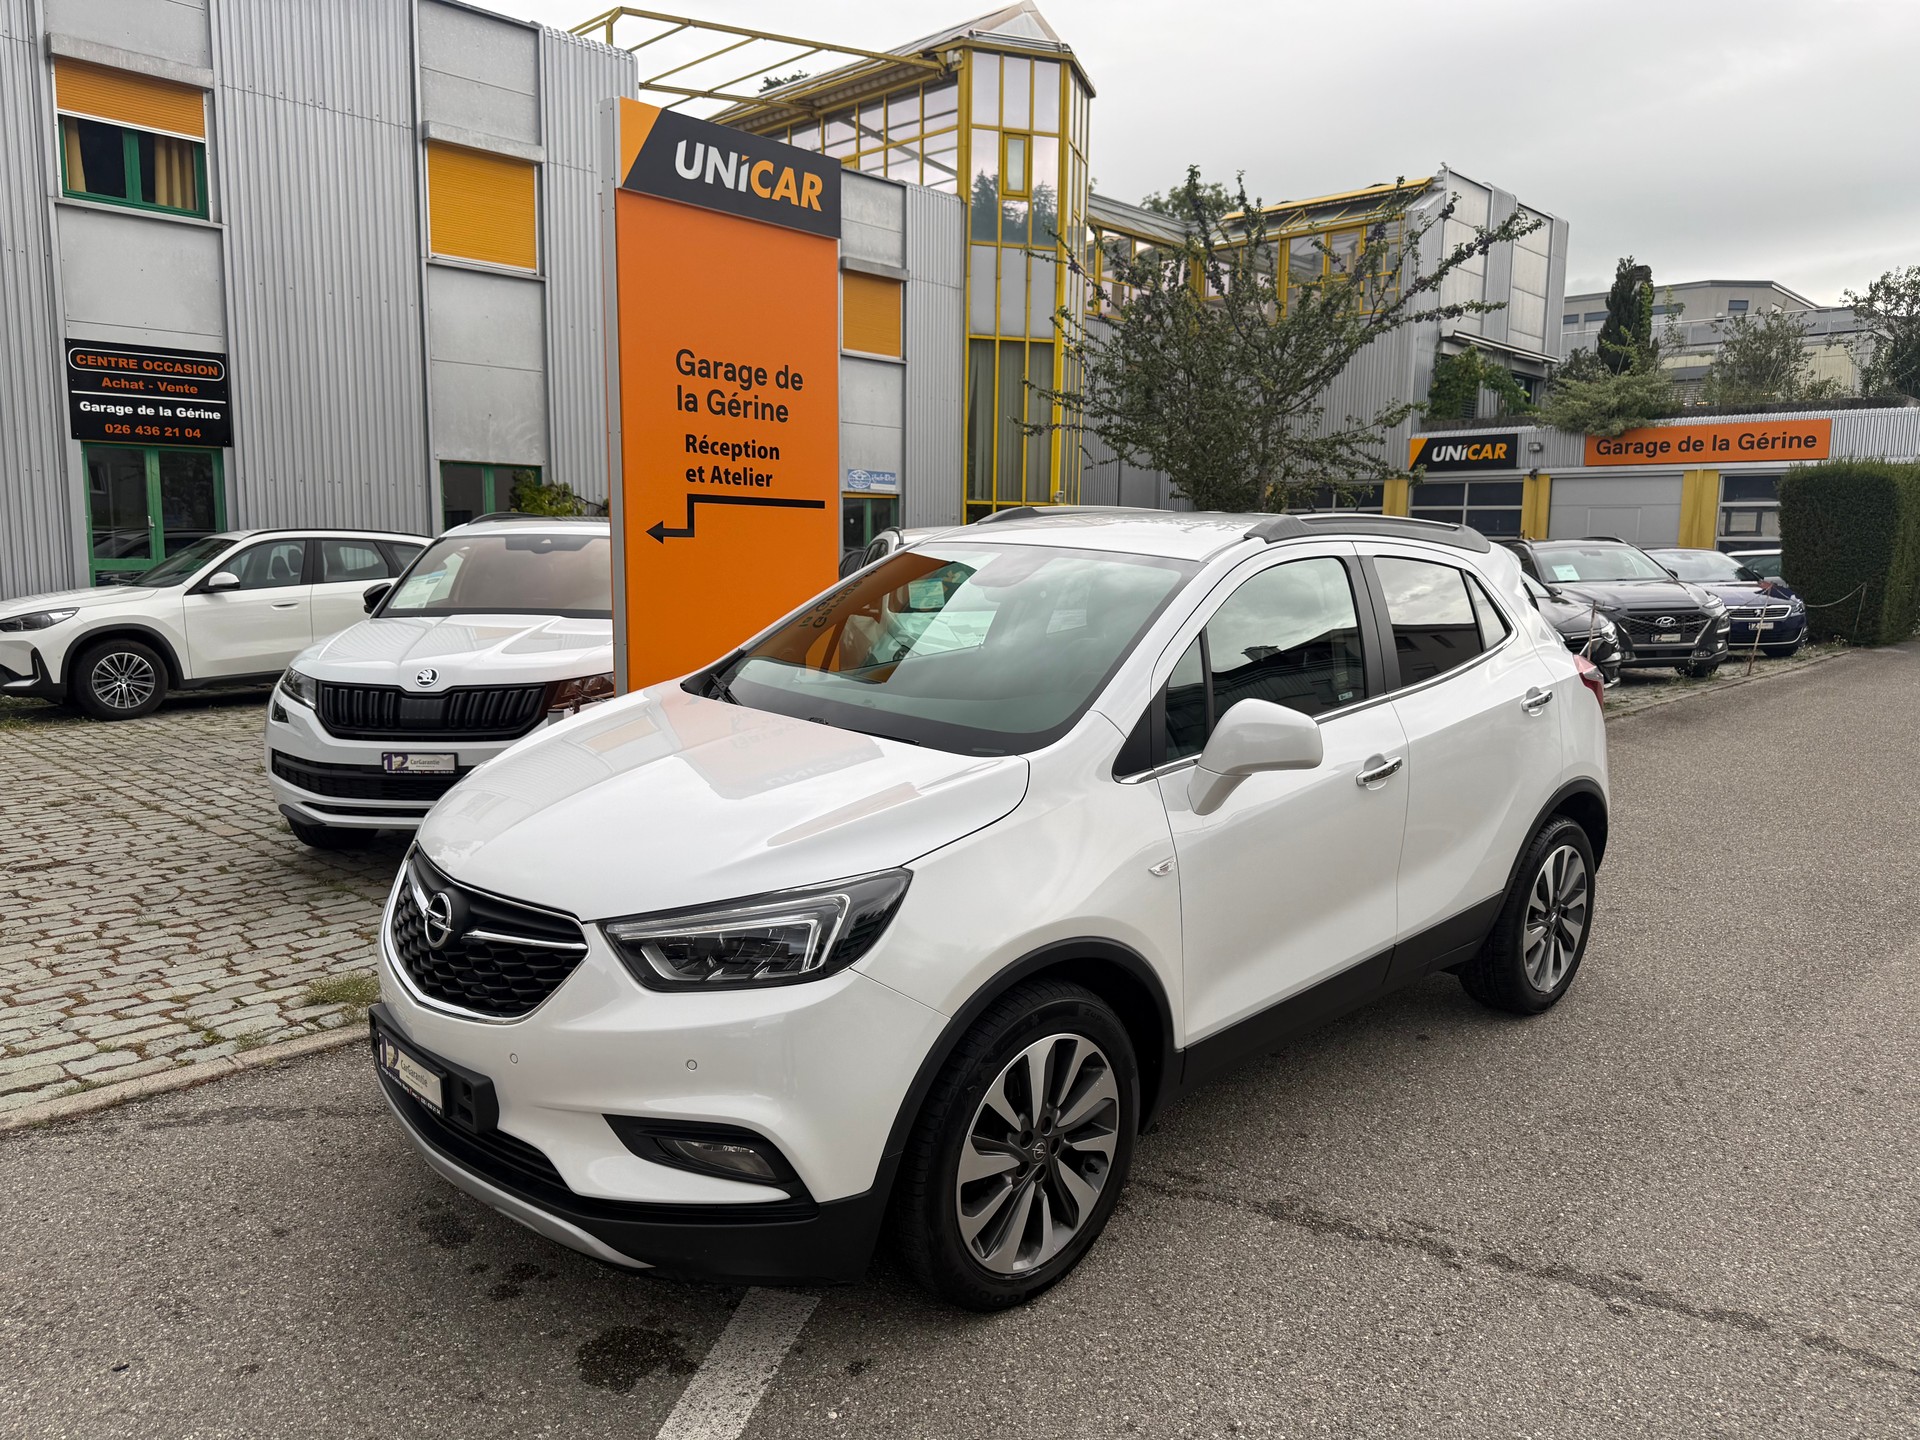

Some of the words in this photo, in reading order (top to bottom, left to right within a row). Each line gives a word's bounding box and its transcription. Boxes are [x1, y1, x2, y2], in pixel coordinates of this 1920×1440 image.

[76, 354, 138, 369] CENTRE
[143, 360, 218, 376] OCCASION
[675, 348, 768, 391] Garage
[775, 364, 804, 391] de
[102, 377, 145, 390] Achat
[157, 381, 198, 394] Vente
[79, 401, 133, 416] Garage
[138, 405, 155, 416] de
[159, 406, 172, 417] la
[176, 407, 221, 420] Gérine
[676, 384, 698, 412] la
[706, 389, 789, 423] Gérine
[104, 424, 131, 435] 026
[135, 425, 160, 436] 436
[164, 427, 180, 437] 21
[185, 428, 201, 438] 04
[685, 433, 780, 462] Réception
[1596, 438, 1671, 458] Garage
[1677, 435, 1704, 453] de
[1712, 434, 1730, 451] la
[1737, 431, 1817, 450] Gérine
[685, 466, 705, 483] et
[710, 465, 773, 488] Atelier
